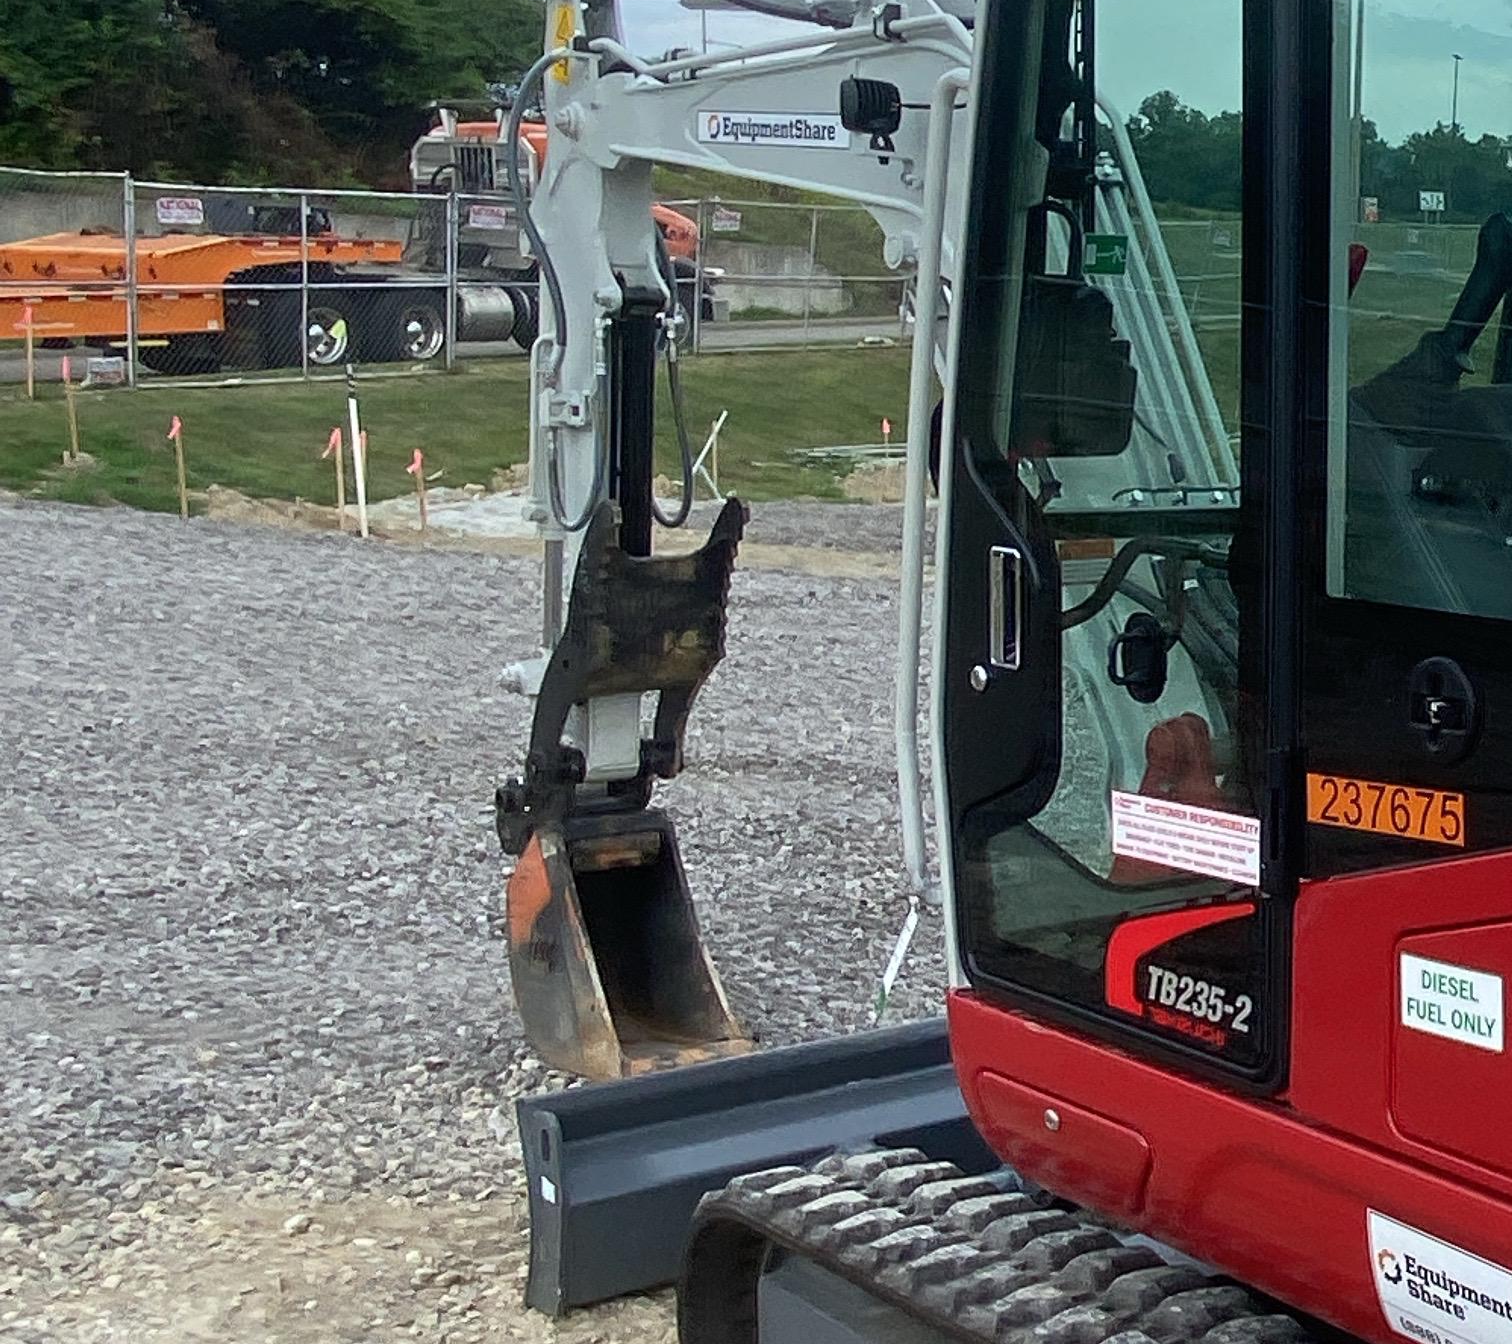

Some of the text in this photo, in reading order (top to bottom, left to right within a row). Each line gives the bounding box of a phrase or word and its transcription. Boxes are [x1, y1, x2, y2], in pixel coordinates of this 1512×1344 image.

[722, 117, 836, 142] EquipmentShare
[1320, 778, 1460, 841] 237675
[1148, 965, 1252, 1033] TB235-2
[1421, 969, 1479, 1003] DIESEL
[1407, 997, 1496, 1038] FUEL ONLY
[1407, 1279, 1466, 1321] Share
